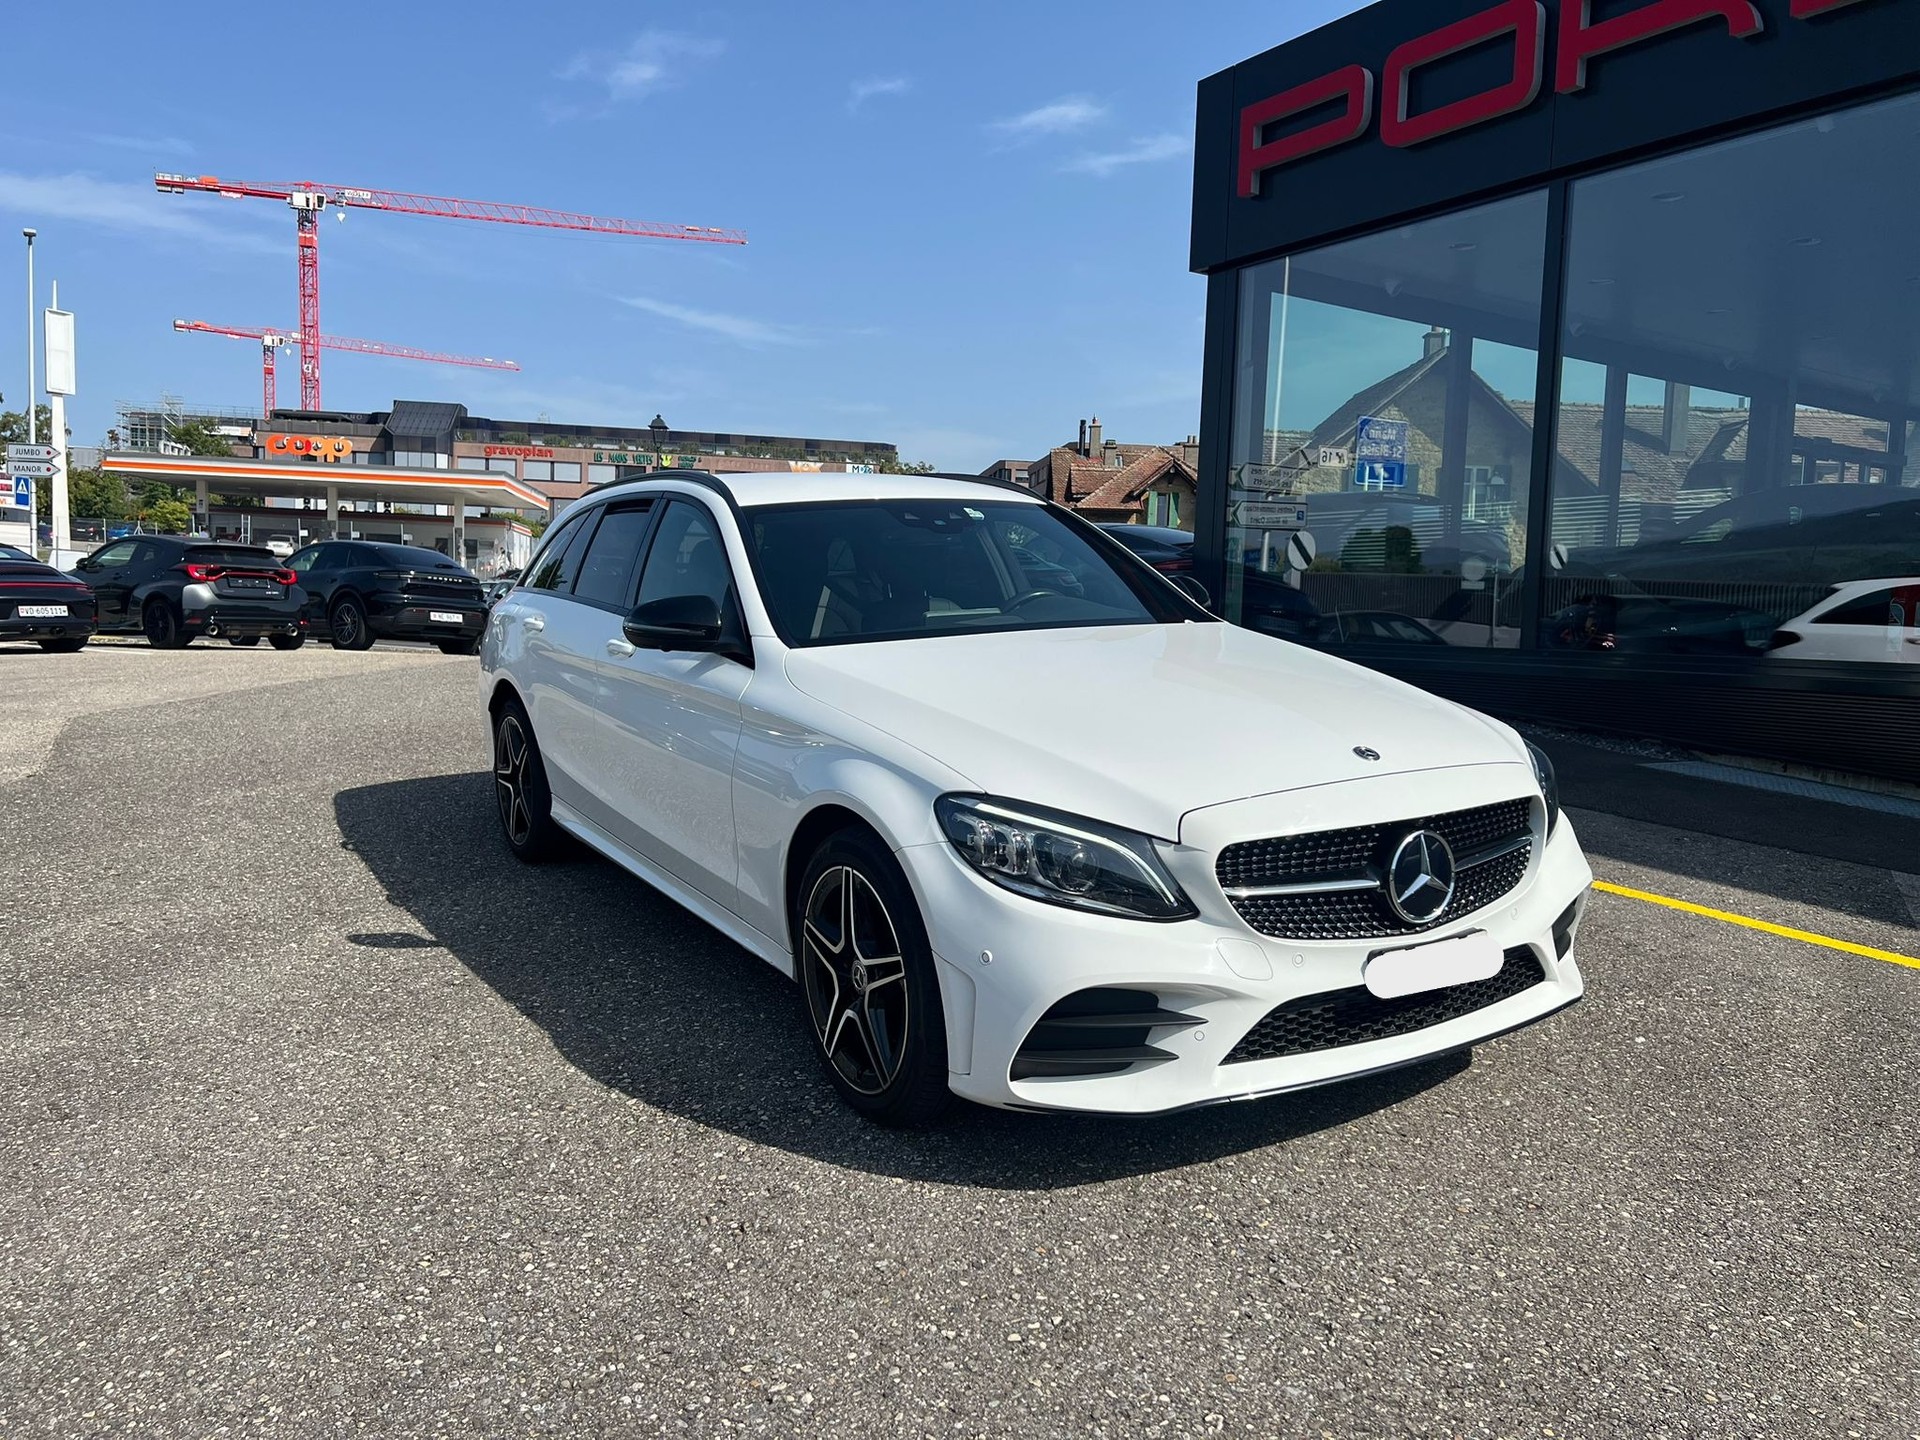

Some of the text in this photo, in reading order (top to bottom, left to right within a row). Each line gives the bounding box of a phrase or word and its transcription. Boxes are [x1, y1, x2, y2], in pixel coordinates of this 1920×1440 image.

[15, 448, 41, 456] JUMBO
[266, 434, 353, 463] coop
[484, 445, 554, 459] gravoplan
